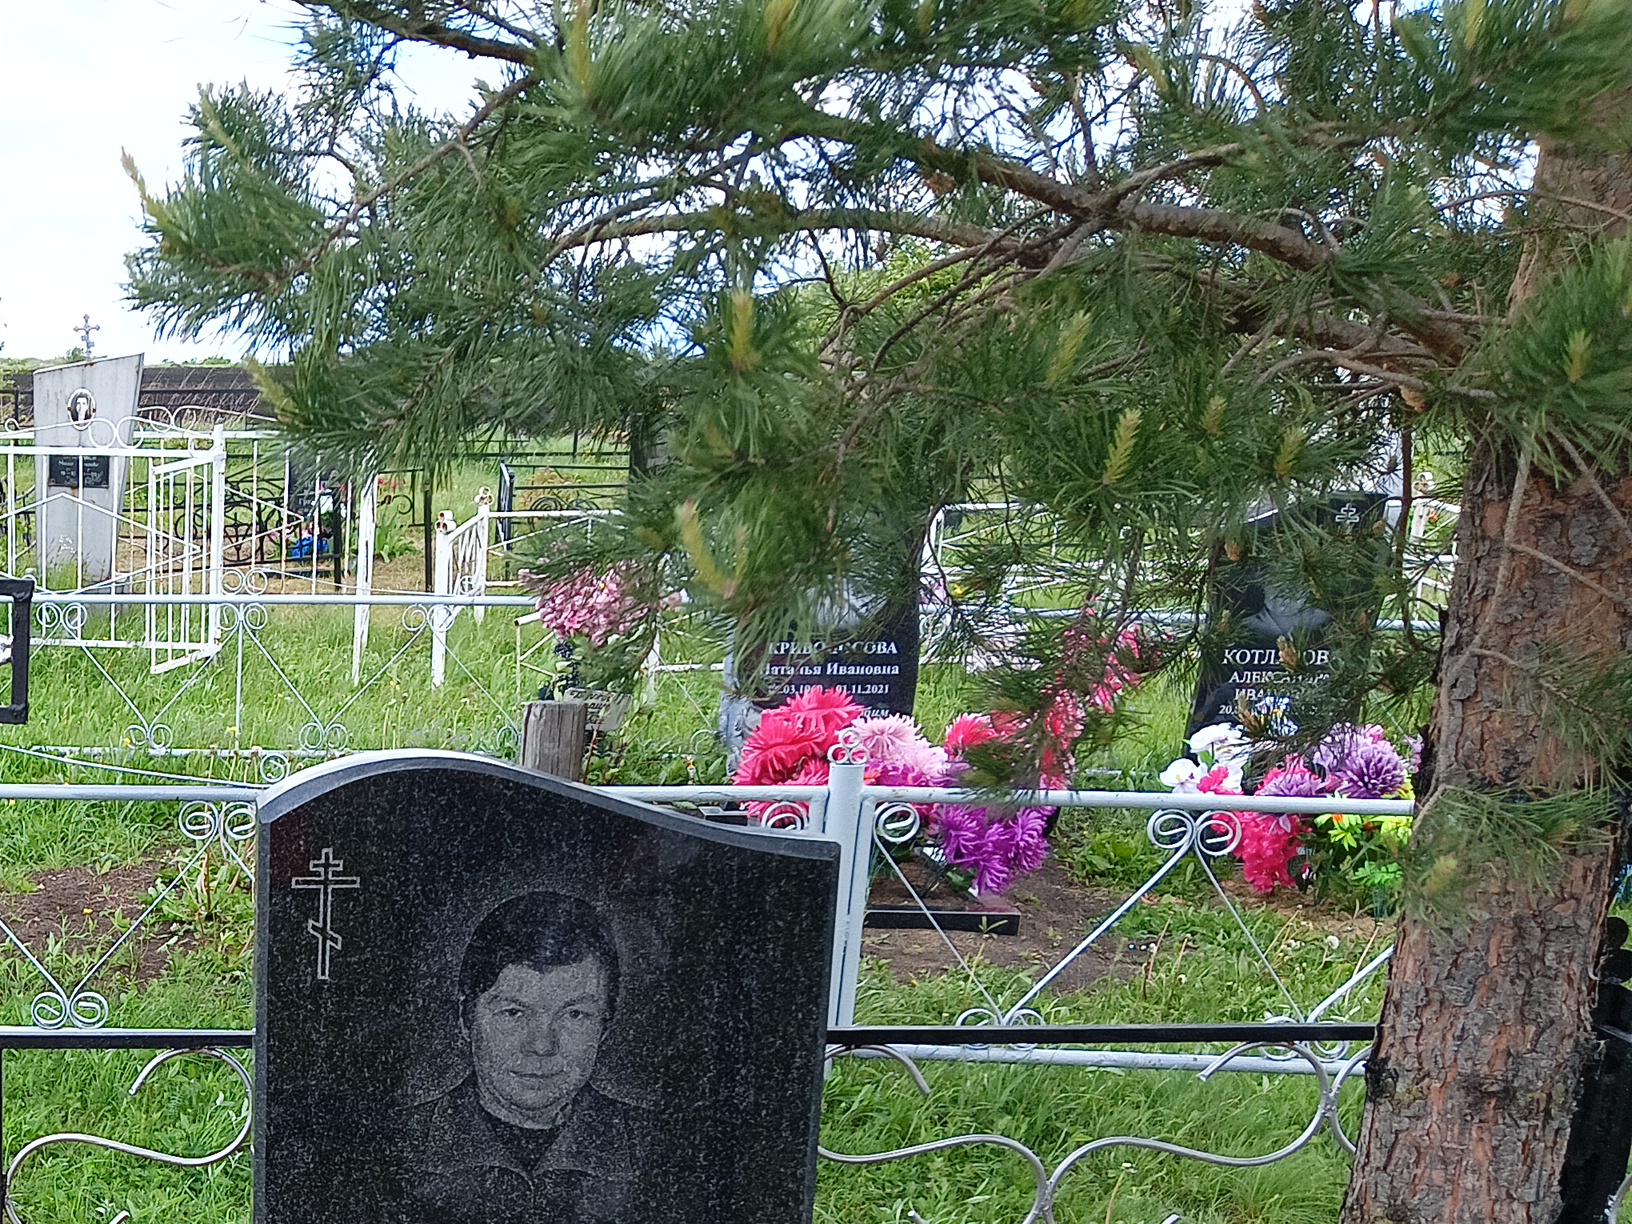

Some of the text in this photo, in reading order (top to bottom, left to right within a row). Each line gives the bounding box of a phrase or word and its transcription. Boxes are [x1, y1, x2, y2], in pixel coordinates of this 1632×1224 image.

[769, 641, 898, 655] КРИВОСОВА
[1222, 649, 1330, 665] КОТЛОВ
[826, 662, 900, 675] Ивановна
